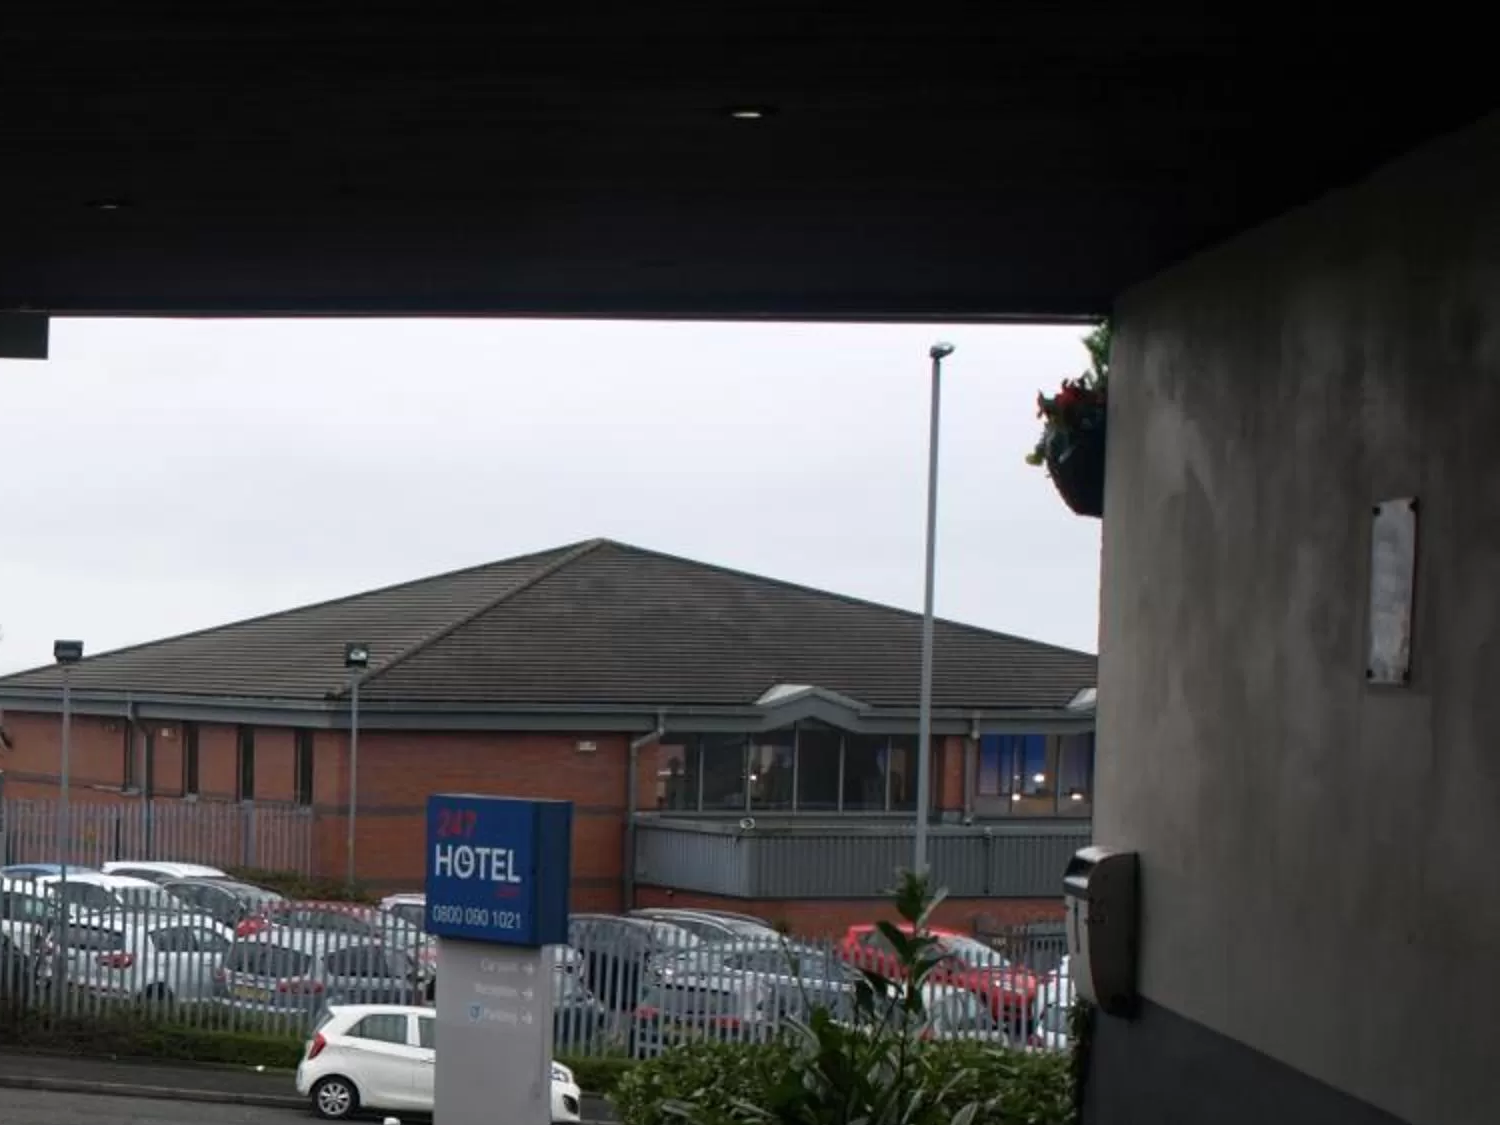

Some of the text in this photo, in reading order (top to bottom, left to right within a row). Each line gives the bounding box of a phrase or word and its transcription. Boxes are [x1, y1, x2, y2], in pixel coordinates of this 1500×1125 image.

[437, 808, 477, 837] 247
[435, 844, 521, 883] HOTEL
[433, 904, 521, 930] 0800 090 1021
